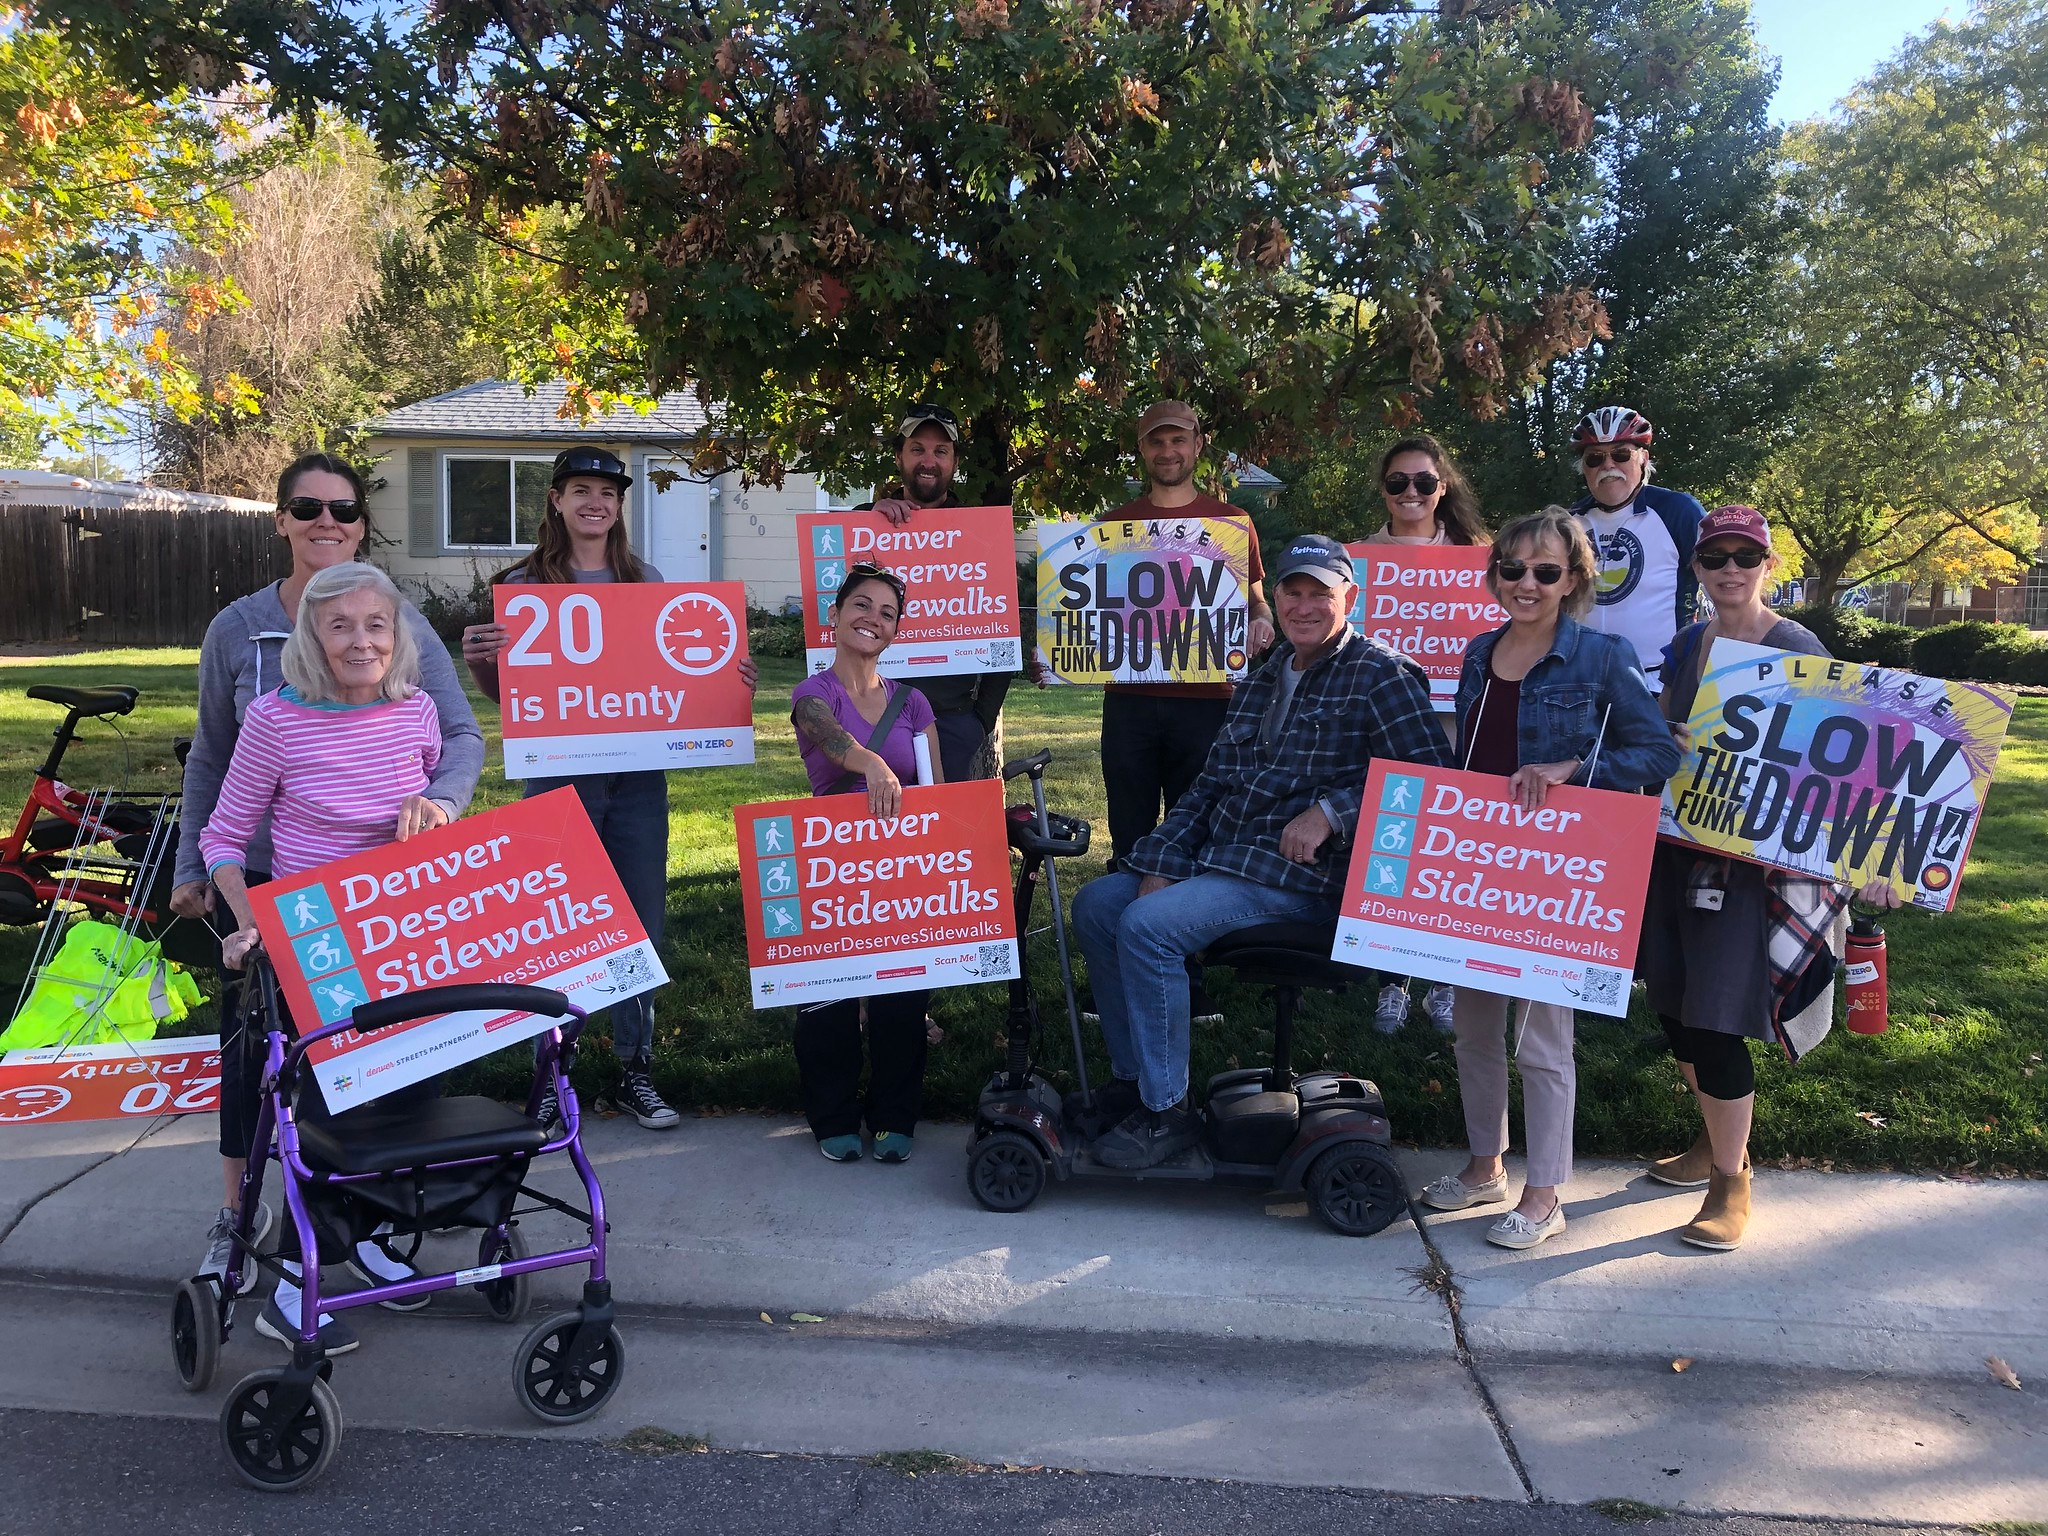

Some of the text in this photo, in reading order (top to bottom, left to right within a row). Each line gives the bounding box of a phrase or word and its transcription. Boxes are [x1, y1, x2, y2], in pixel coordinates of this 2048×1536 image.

[851, 527, 962, 552] Denver
[1074, 522, 1211, 551] PLEASE
[1618, 533, 1639, 558] CANAL
[882, 561, 988, 583] serves
[1059, 560, 1225, 609] SLOW
[1373, 561, 1487, 588] Denver
[901, 587, 1007, 619] ewalks
[505, 593, 604, 667] 20
[1052, 610, 1098, 646] THE
[1373, 626, 1468, 655] Sidew
[1052, 647, 1096, 673] FUNK
[510, 685, 686, 723] is Plenty
[1758, 660, 1953, 718] PLEASE
[666, 739, 734, 751] VISION ZERO
[1712, 694, 1963, 798] SLOW
[1691, 746, 1760, 803] THE
[1427, 783, 1582, 833] Denver
[1673, 789, 1743, 836] FUNK
[801, 811, 940, 847] Denver
[805, 850, 973, 888] Deserves
[1419, 825, 1607, 882] Deserves
[339, 834, 512, 914] Denver
[356, 861, 569, 956] Deserves
[810, 879, 999, 930] Sidewalks
[1412, 867, 1626, 933] Sidewalks
[375, 892, 614, 999] Sidewalks
[766, 920, 1002, 960] #DenverDeservesSidewalks
[1359, 899, 1619, 961] #DenverDeservesSidewalks
[934, 953, 977, 966] Scan Me!
[1391, 946, 1418, 957] STREETS
[1418, 951, 1462, 965] PARTNERSHIP
[1532, 964, 1583, 981] Scan Me!
[555, 969, 608, 993] Scan Me!
[807, 978, 832, 987] STREETS
[833, 974, 873, 984] PARTNERSHIP
[58, 1058, 189, 1080] Plenty
[366, 1029, 480, 1078] denver STREETS PARTNERSHIP
[120, 1077, 222, 1113] 20
